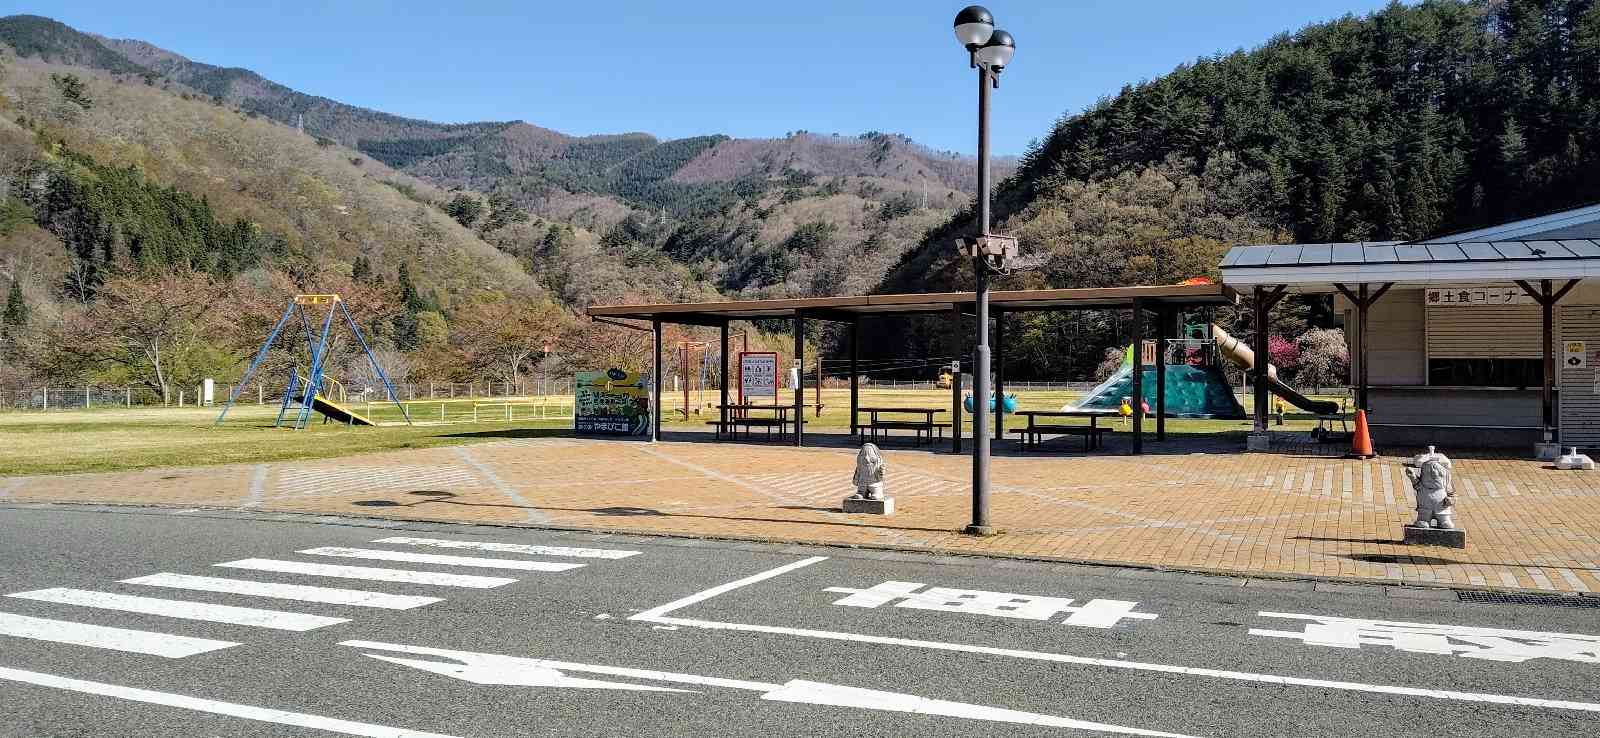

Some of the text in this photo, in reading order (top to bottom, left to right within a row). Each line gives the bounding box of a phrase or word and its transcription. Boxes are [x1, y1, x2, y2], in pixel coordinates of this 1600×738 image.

[1428, 290, 1533, 303] 郷土食コーナー
